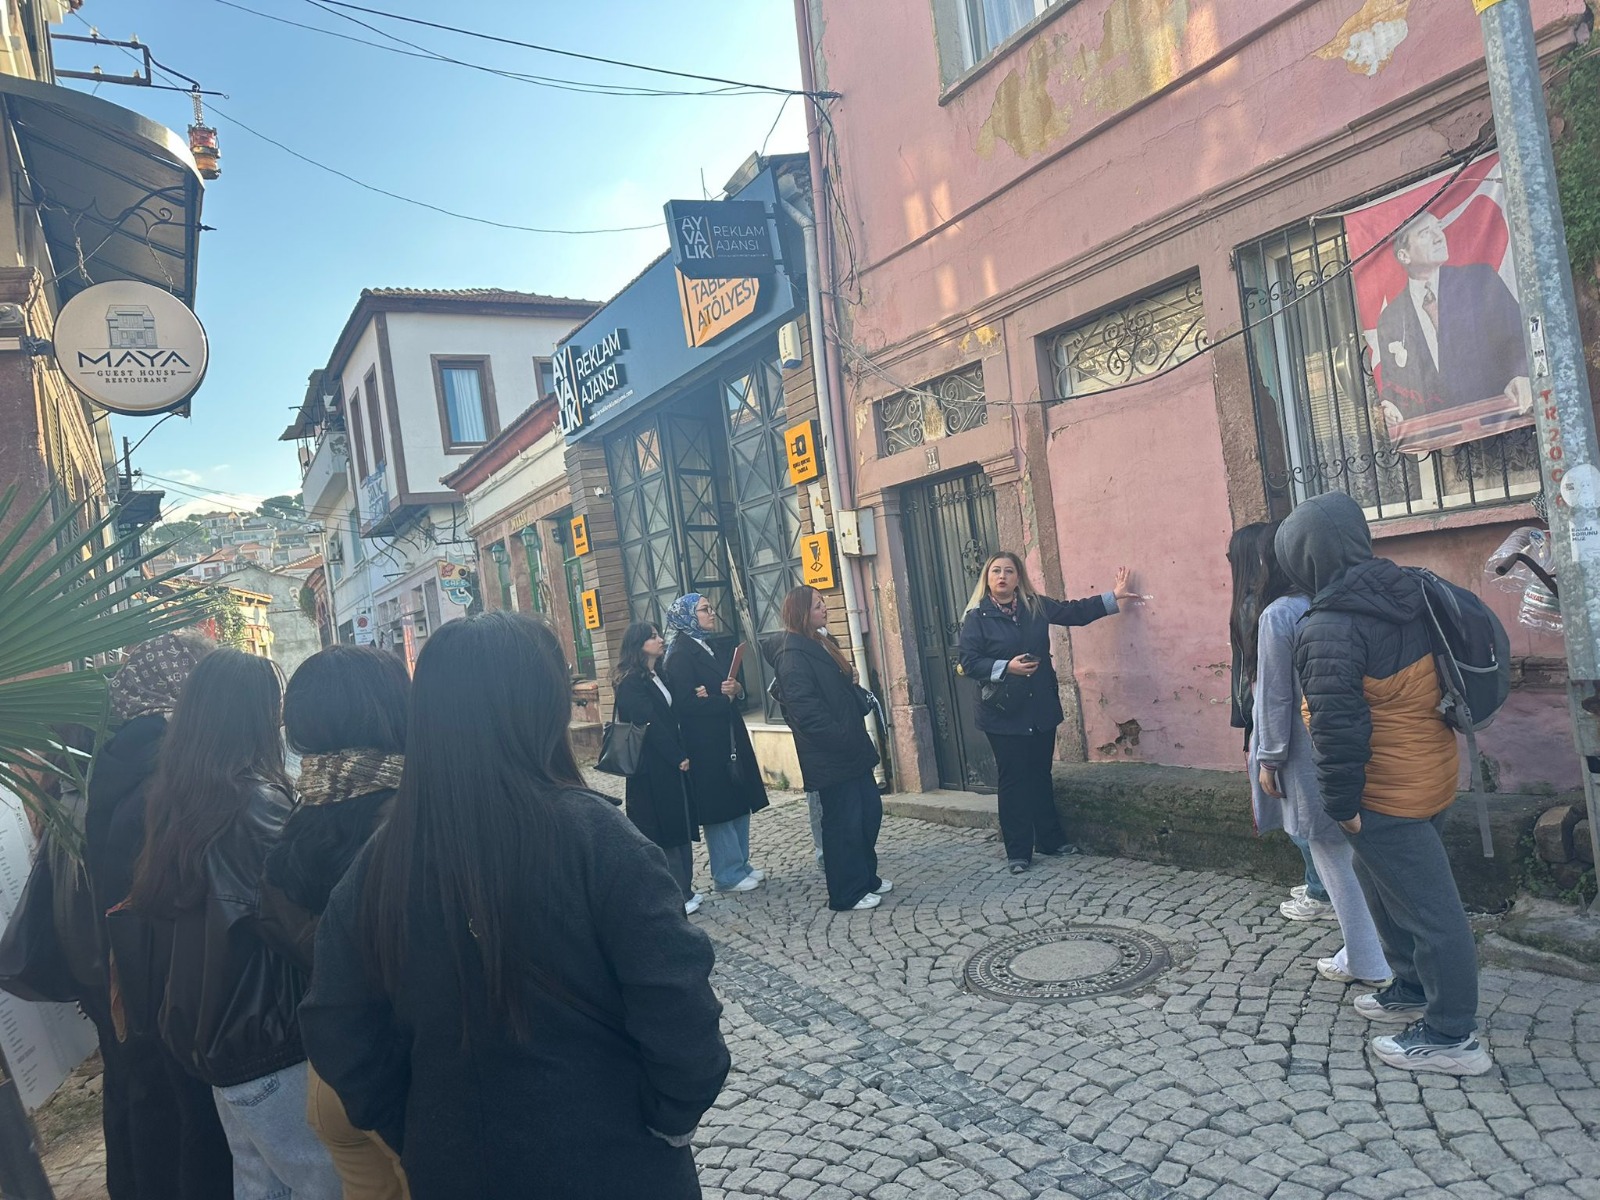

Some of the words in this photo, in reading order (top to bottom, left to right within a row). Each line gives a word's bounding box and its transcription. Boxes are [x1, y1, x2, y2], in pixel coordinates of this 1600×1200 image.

[682, 216, 702, 230] AY
[682, 231, 707, 244] VA
[713, 226, 765, 237] REKLAM
[684, 244, 712, 259] LIK
[716, 240, 760, 251] AJANSI
[77, 350, 191, 368] MAYA
[576, 328, 621, 380] REKLAM
[97, 369, 134, 377] GUEST
[140, 369, 177, 377] HOUSE
[553, 347, 568, 386] AY
[581, 363, 619, 408] AJANSI
[554, 377, 576, 410] VA
[558, 400, 581, 434] LIK
[927, 452, 937, 465] 11
